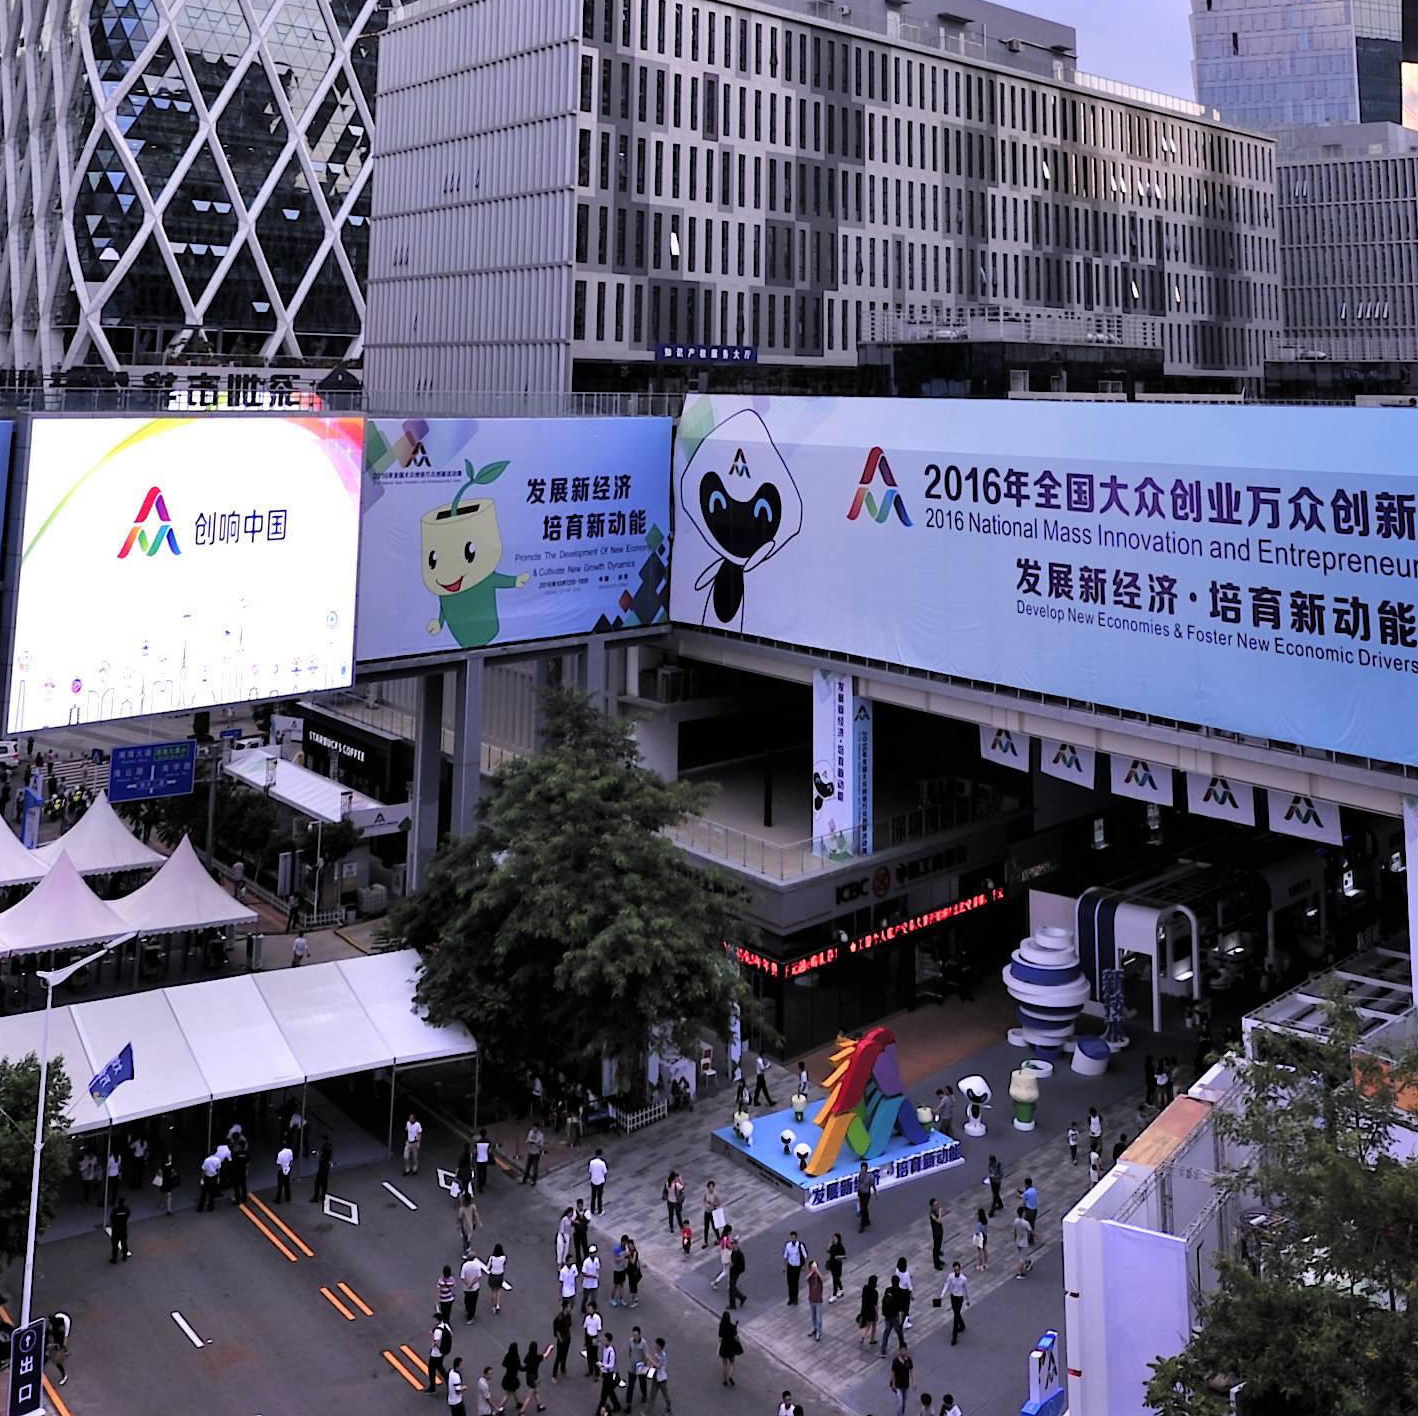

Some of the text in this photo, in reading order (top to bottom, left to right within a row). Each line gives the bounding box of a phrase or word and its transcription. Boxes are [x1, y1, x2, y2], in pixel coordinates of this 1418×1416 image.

[526, 474, 632, 505] 发展新经济
[194, 509, 287, 545] 创响中国
[542, 509, 647, 541] 培育新动能
[925, 508, 965, 532] 2016
[968, 512, 1038, 540] National
[1043, 520, 1092, 545] Mass
[1098, 524, 1203, 557] Innovation
[1209, 538, 1251, 562] and
[1016, 557, 1418, 648] 发展新经济·培育新动能
[1016, 599, 1065, 623] Develop
[1068, 607, 1095, 626] New
[1098, 612, 1170, 637] Economies
[1173, 623, 1182, 639] &
[1187, 624, 1233, 646] Foster
[1237, 632, 1270, 652] New
[1275, 637, 1354, 664] Economic
[836, 879, 869, 905] ICBC
[18, 1355, 34, 1404] 出口
